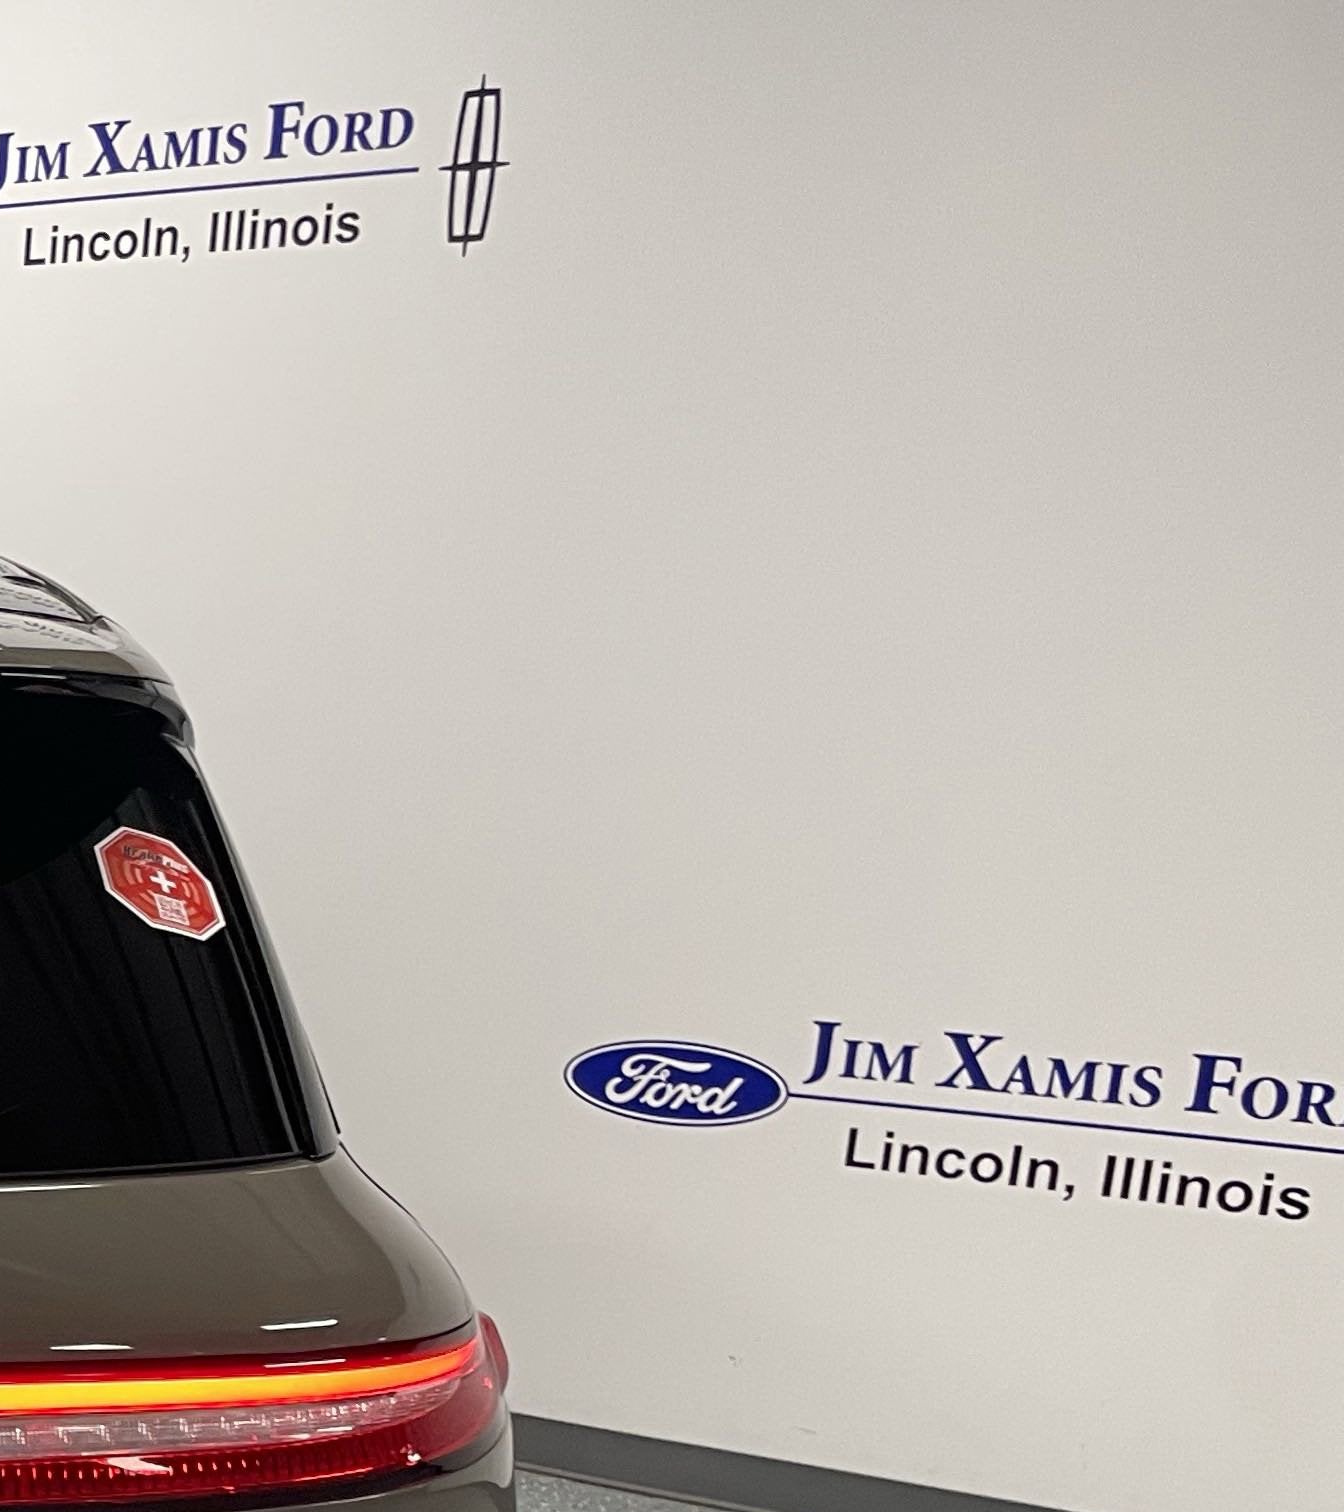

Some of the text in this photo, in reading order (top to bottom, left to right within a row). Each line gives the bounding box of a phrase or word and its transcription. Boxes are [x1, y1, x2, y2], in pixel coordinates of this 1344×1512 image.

[88, 120, 247, 180] XAMIS
[264, 101, 415, 161] FORD
[23, 204, 361, 266] Lincoln, Illinois
[605, 1052, 744, 1117] Ford
[803, 1020, 1344, 1127] JIM XAMIS FOR
[844, 1127, 1312, 1221] Lincoln, Illinois
